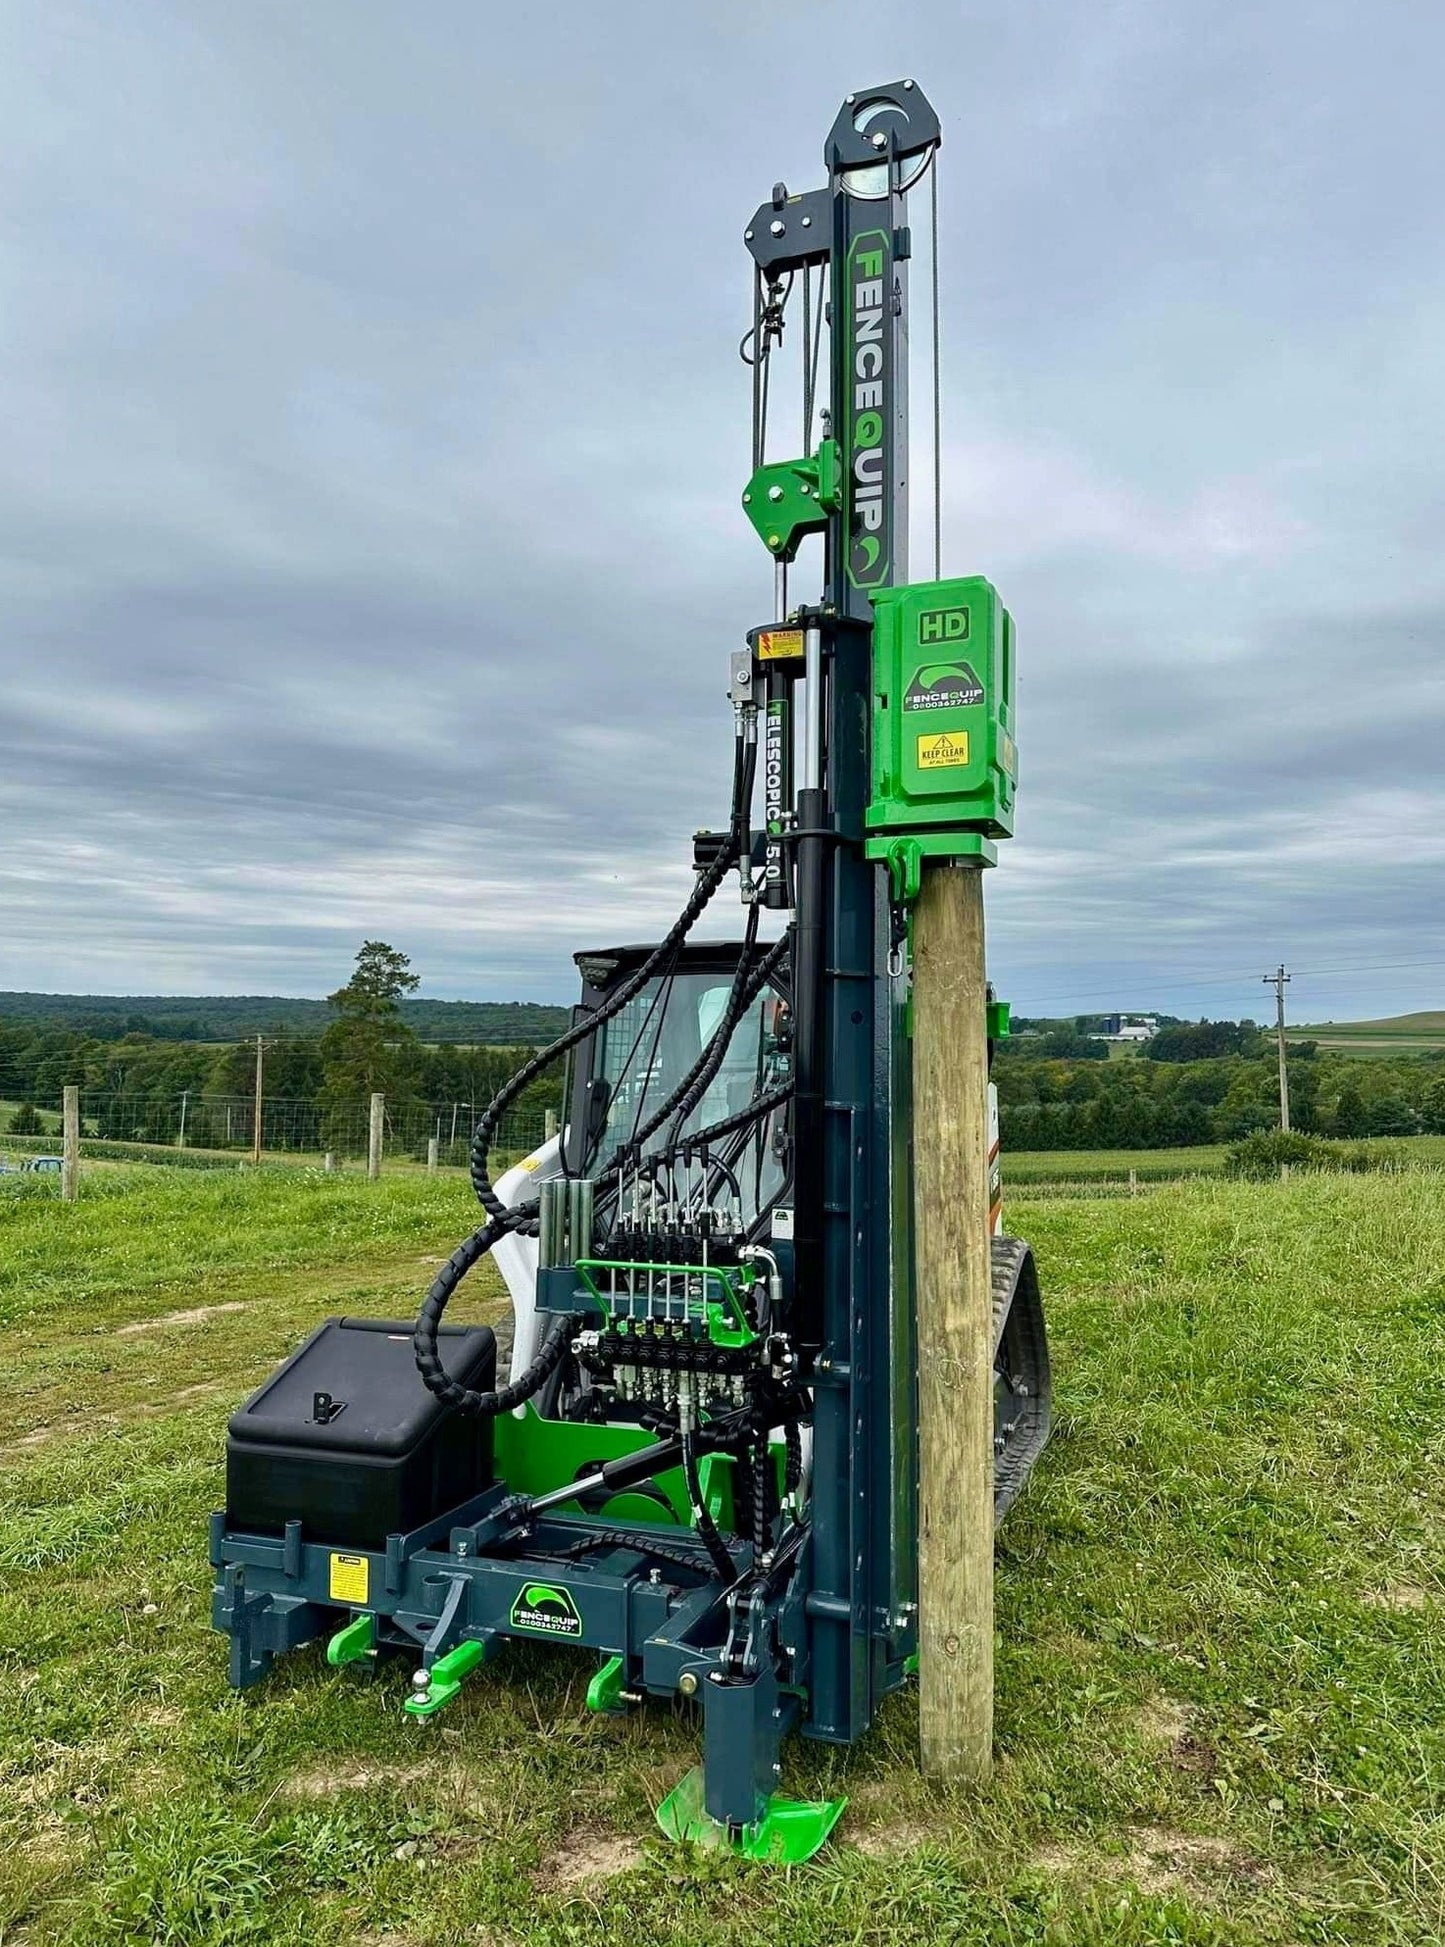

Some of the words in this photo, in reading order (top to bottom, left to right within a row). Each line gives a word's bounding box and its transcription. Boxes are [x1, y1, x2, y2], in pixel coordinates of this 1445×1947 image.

[854, 252, 884, 531] FENCEQUIP
[922, 612, 966, 640] HD
[905, 689, 983, 704] FENCEQUIP
[767, 703, 781, 821] TELESCOPIC
[922, 750, 941, 759] KEEP
[941, 748, 964, 758] CLEAR
[514, 1610, 578, 1625] FENCEQUIP
